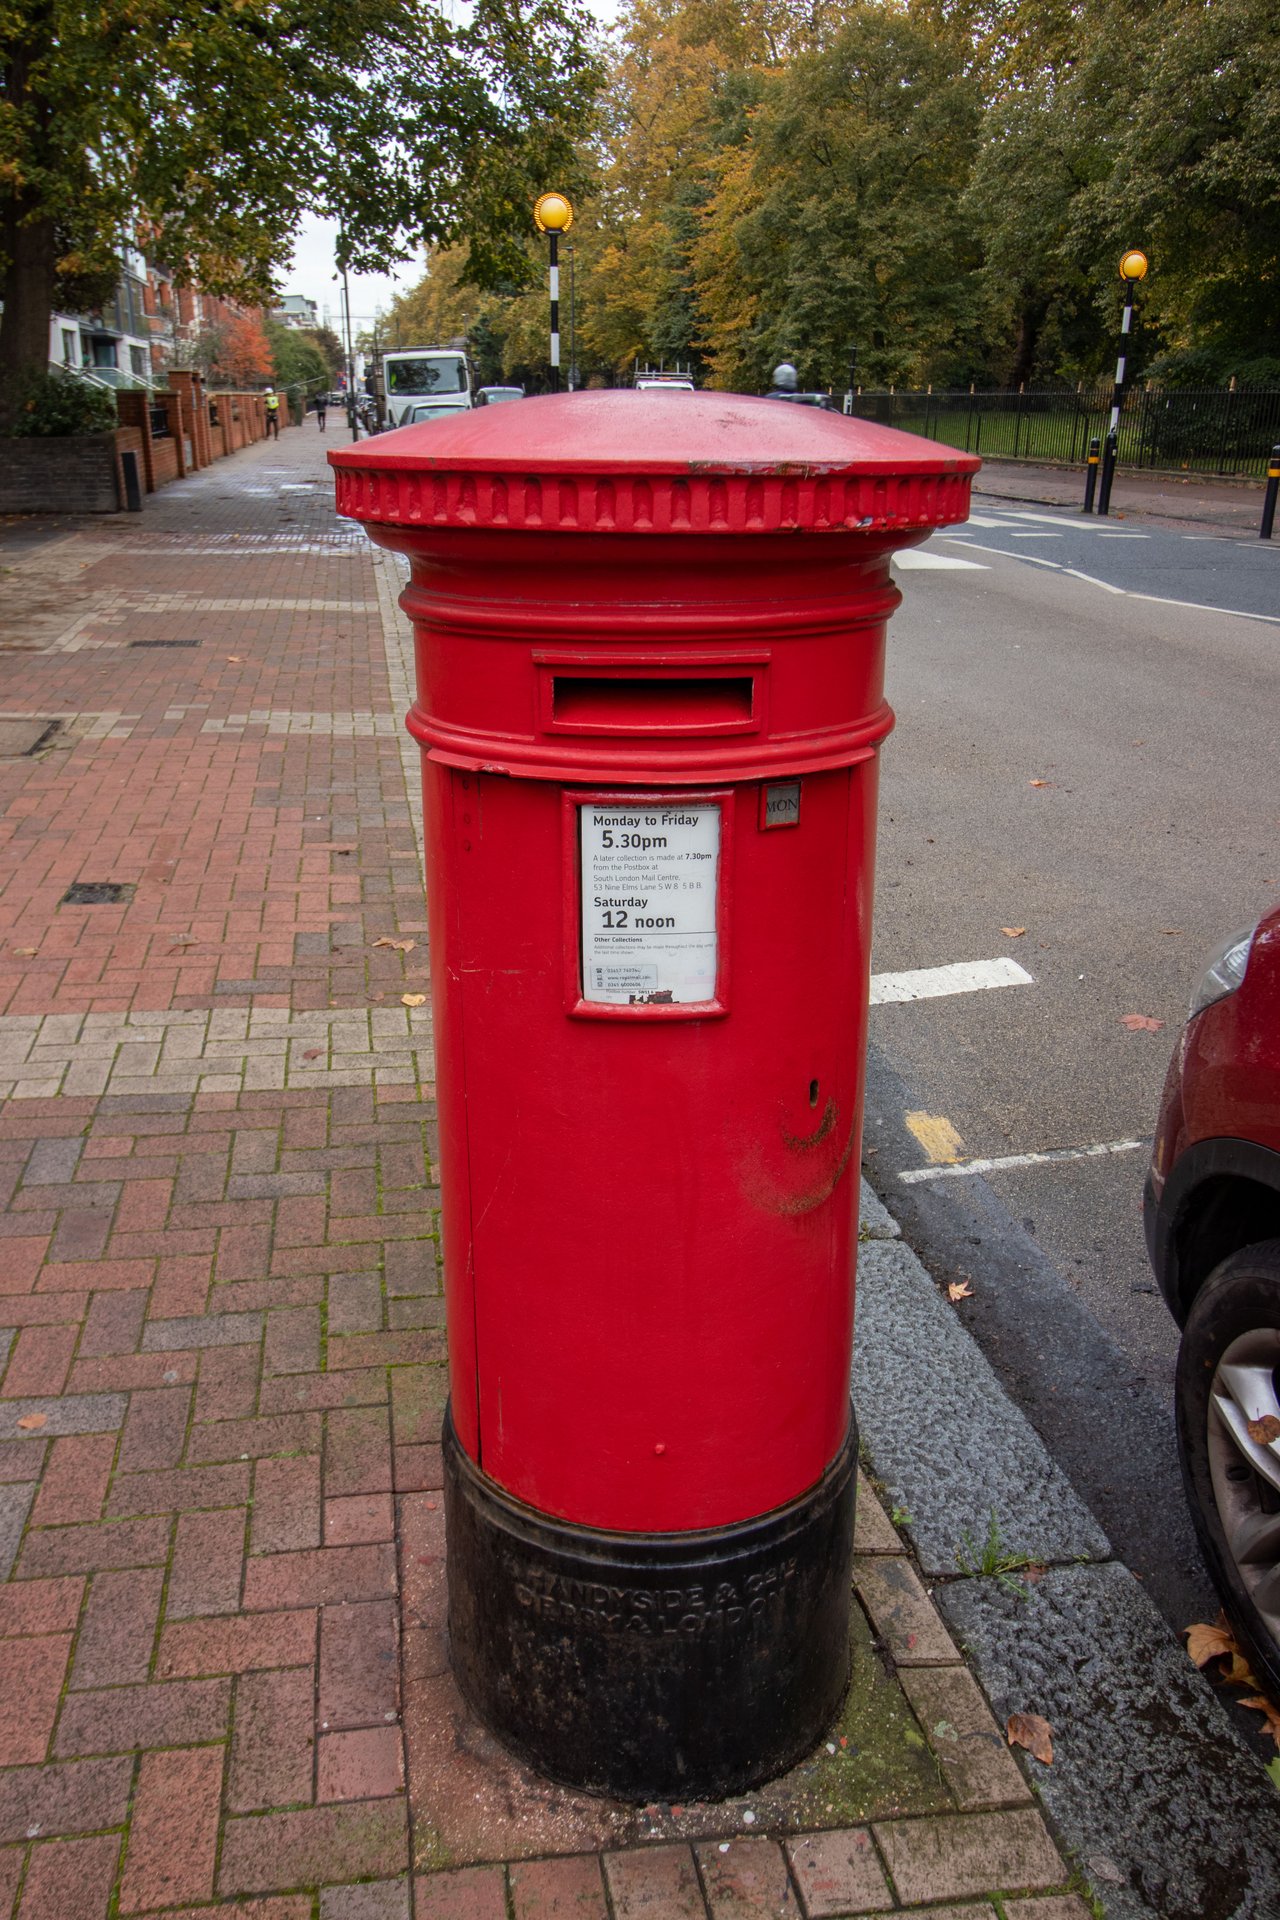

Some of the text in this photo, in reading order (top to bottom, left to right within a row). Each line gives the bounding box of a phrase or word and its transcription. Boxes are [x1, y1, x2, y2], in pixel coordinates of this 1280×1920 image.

[766, 798, 798, 813] MON
[593, 814, 699, 828] Monday to Friday
[601, 830, 667, 851] 5.30pm
[685, 852, 712, 861] 7.30pm
[593, 863, 610, 871] from
[611, 863, 622, 871] the
[623, 863, 649, 871] Postbox
[593, 874, 613, 882] South
[615, 874, 640, 882] London
[641, 874, 656, 882] Mail
[593, 883, 603, 891] 53
[604, 883, 620, 891] Nine
[622, 883, 638, 891] Elms
[594, 896, 649, 909] Saturday
[601, 910, 675, 929] 12 noon
